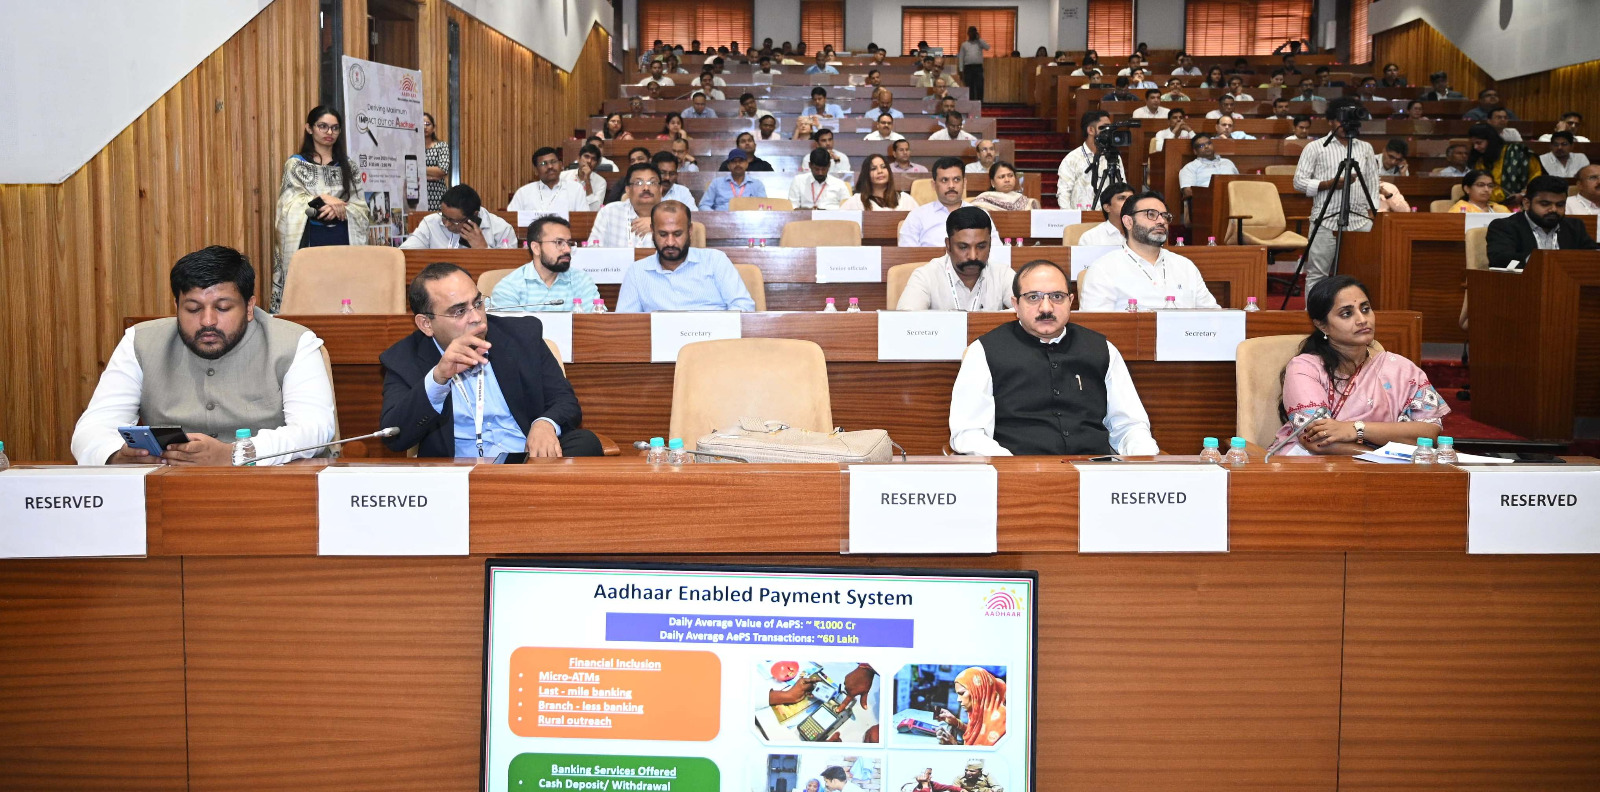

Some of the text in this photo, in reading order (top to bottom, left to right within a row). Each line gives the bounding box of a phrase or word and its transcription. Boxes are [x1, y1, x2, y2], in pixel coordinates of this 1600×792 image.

[359, 115, 377, 125] IMPACT
[378, 118, 387, 126] OUT
[680, 330, 711, 338] Secretary
[1184, 330, 1217, 338] Secretary
[24, 495, 104, 509] RESERVED
[350, 495, 428, 508] RESERVED
[880, 492, 957, 505] RESERVED
[1111, 491, 1187, 504] RESERVED
[1500, 494, 1578, 507] RESERVED
[594, 583, 913, 608] Aadhaar Enabled Payment System
[669, 617, 693, 628] Daily
[694, 618, 733, 629] Average
[735, 619, 761, 628] Value
[763, 619, 775, 628] of
[845, 621, 856, 630] Cr
[659, 630, 683, 641] Daily
[685, 631, 724, 642] Average
[726, 632, 751, 641] AePS
[753, 632, 815, 643] Transactions:
[837, 634, 859, 644] Lakh
[569, 657, 661, 670] Financial Inclusion
[539, 671, 600, 683] Micro-ATMs
[539, 686, 559, 696] Last
[567, 686, 590, 697] mile
[592, 687, 632, 699] banking
[538, 700, 573, 711] Branch
[582, 701, 601, 712] less
[603, 702, 644, 714] banking
[538, 715, 612, 727] Rural outreach
[551, 764, 677, 778] Banking Services Offered
[539, 779, 671, 792] Cash Deposit/ Withdrawal
